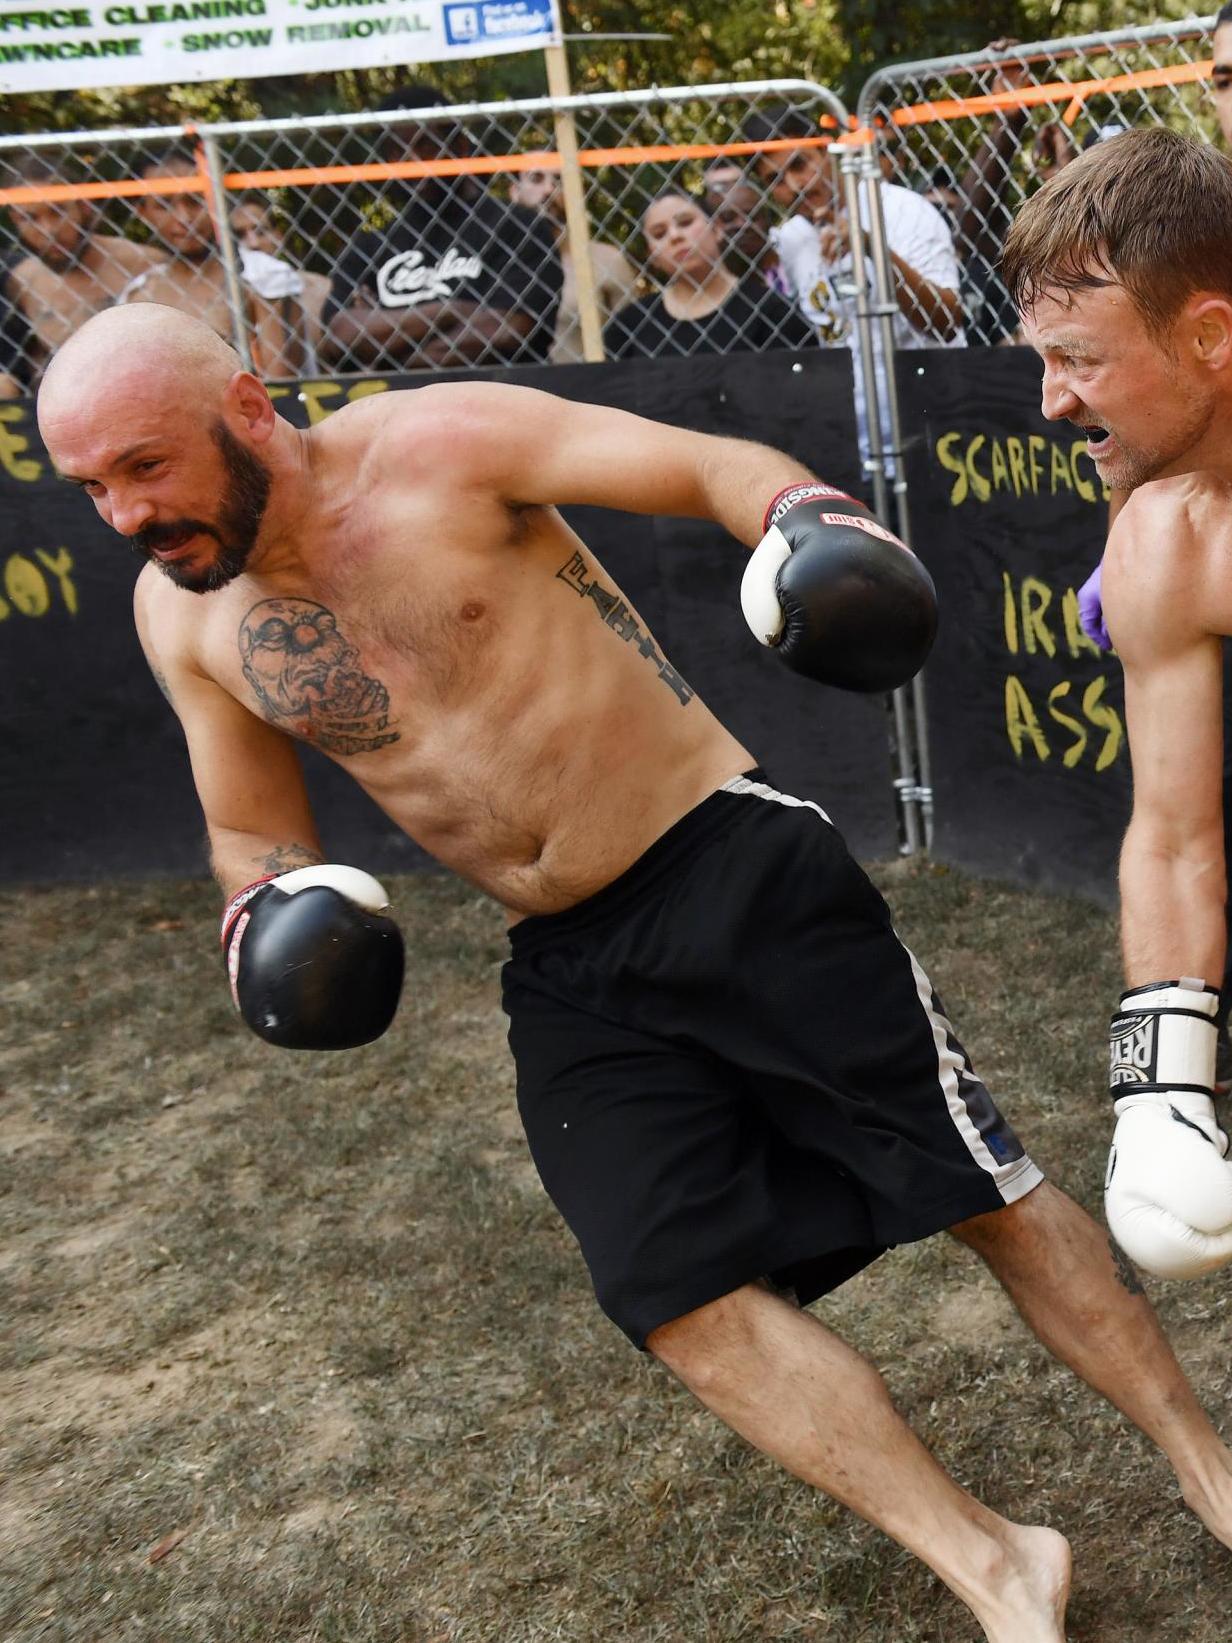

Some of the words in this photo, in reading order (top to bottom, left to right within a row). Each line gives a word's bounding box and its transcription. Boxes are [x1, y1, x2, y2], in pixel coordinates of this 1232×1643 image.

[105, 0, 267, 25] CLEANING
[182, 28, 273, 53] SNOW
[287, 14, 431, 43] REMOVAL
[937, 432, 1112, 506] SCARFAC
[0, 547, 78, 620] OY
